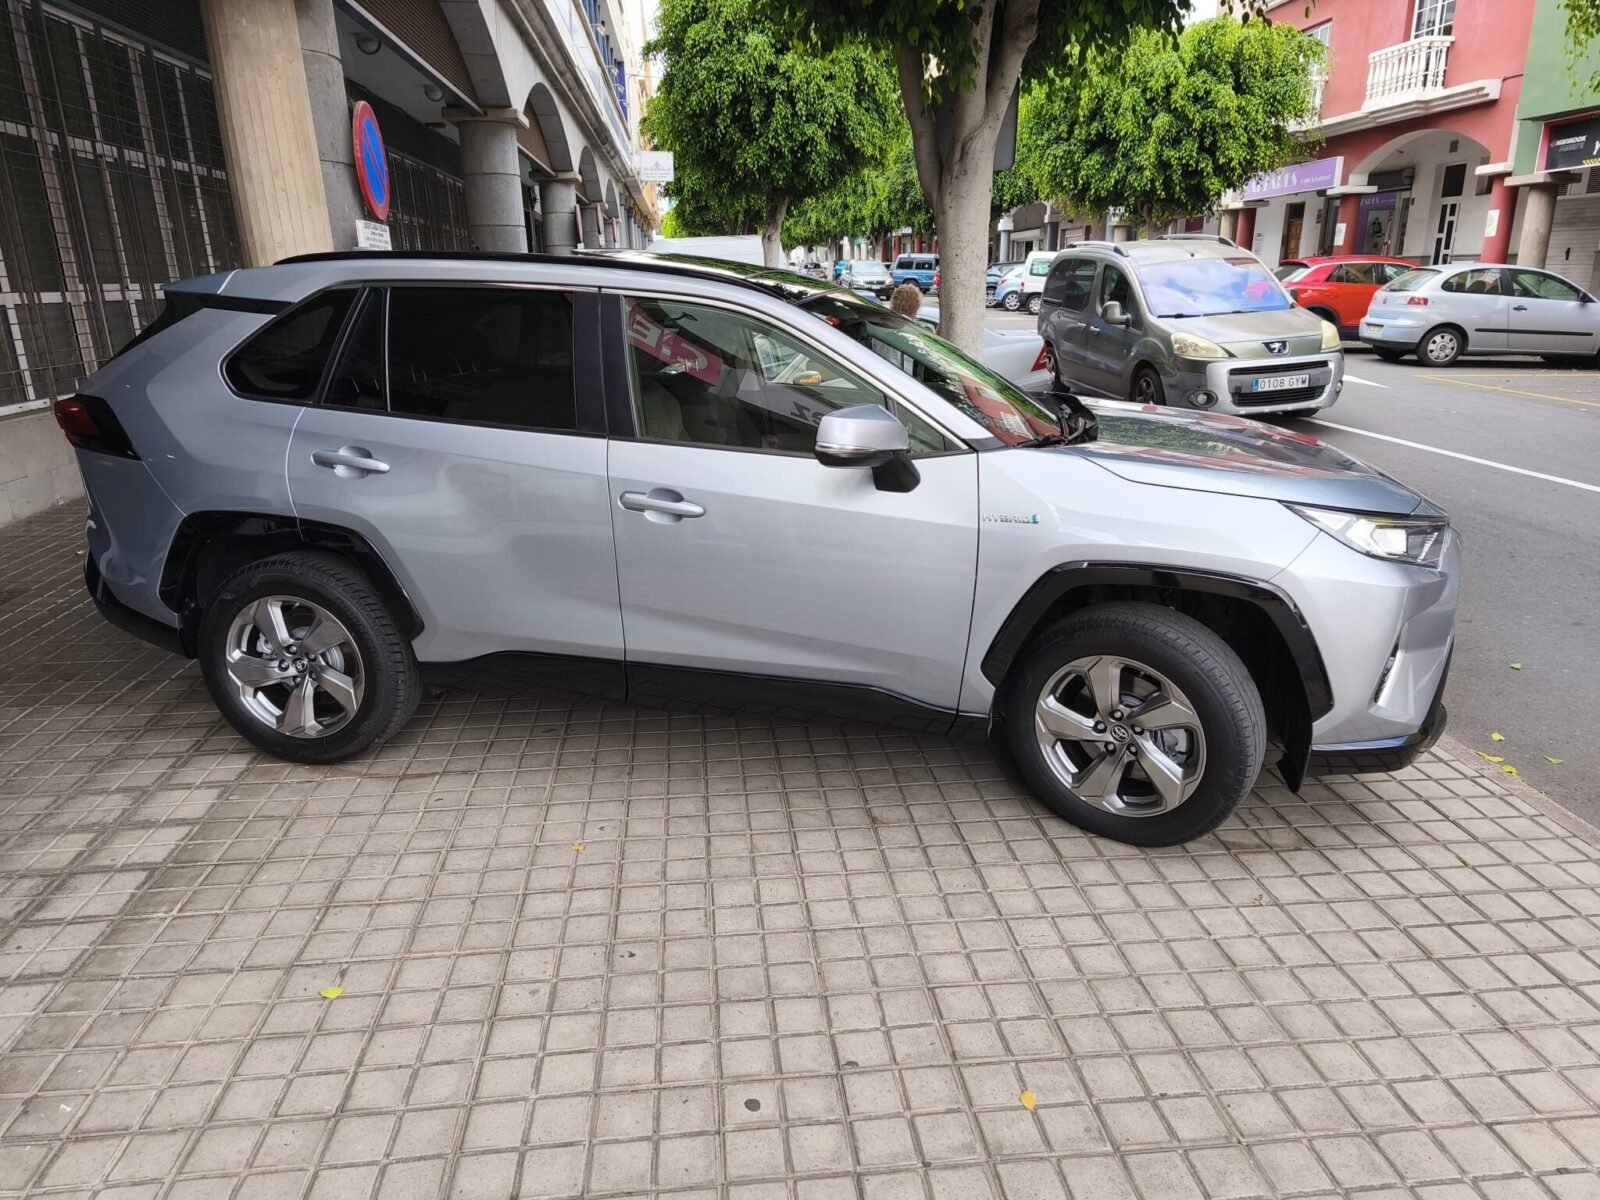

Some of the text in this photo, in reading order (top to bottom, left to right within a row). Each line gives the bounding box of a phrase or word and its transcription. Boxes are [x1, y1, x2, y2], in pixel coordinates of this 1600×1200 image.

[1259, 376, 1307, 390] 0108 GYM
[982, 512, 1030, 524] HYBRID
